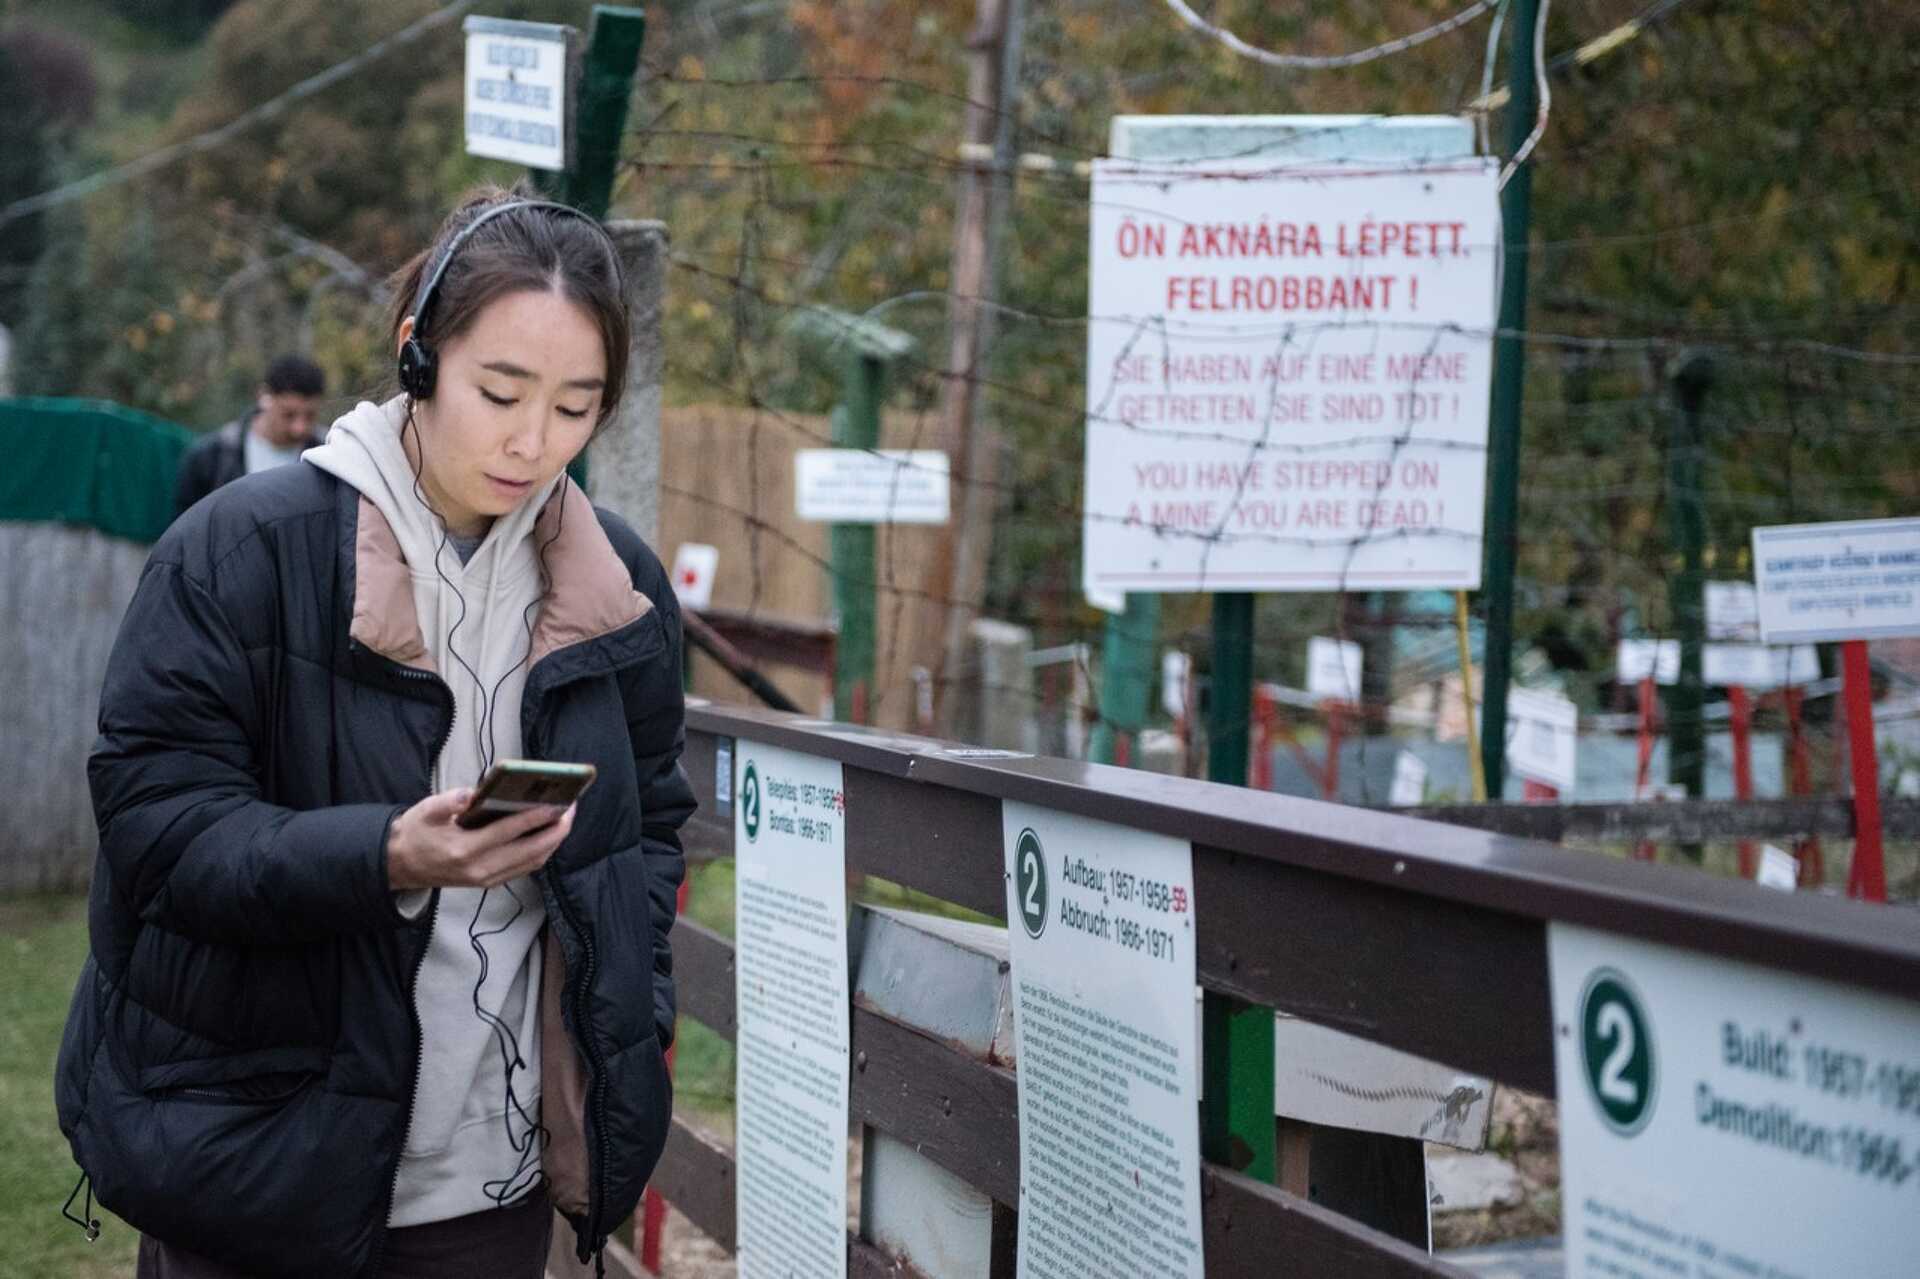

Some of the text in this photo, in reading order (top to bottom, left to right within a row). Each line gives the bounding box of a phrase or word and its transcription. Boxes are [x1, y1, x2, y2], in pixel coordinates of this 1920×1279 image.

[1117, 217, 1165, 259] ÖN
[1178, 213, 1323, 257] AKNÁRA
[1166, 275, 1419, 311] FELROBBANT !
[1114, 353, 1153, 383] SIE
[1161, 353, 1252, 384] HABEN
[1260, 353, 1312, 382] AUF
[1319, 353, 1377, 383] EINE
[1272, 393, 1312, 423] SIE
[1321, 393, 1384, 422] SIND
[1393, 393, 1443, 421] TOT
[1133, 459, 1440, 489] YOU HAVE STEPPED ON
[1127, 501, 1142, 527] A
[1235, 500, 1287, 528] YOU
[1296, 499, 1346, 528] ARE
[1358, 499, 1429, 528] DEAD
[745, 777, 758, 826] 2
[1023, 851, 1040, 916] 2
[1062, 854, 1107, 893] Aufbau:
[1061, 897, 1176, 963] Abbruch: 1966-1971
[1596, 1000, 1639, 1105] 2
